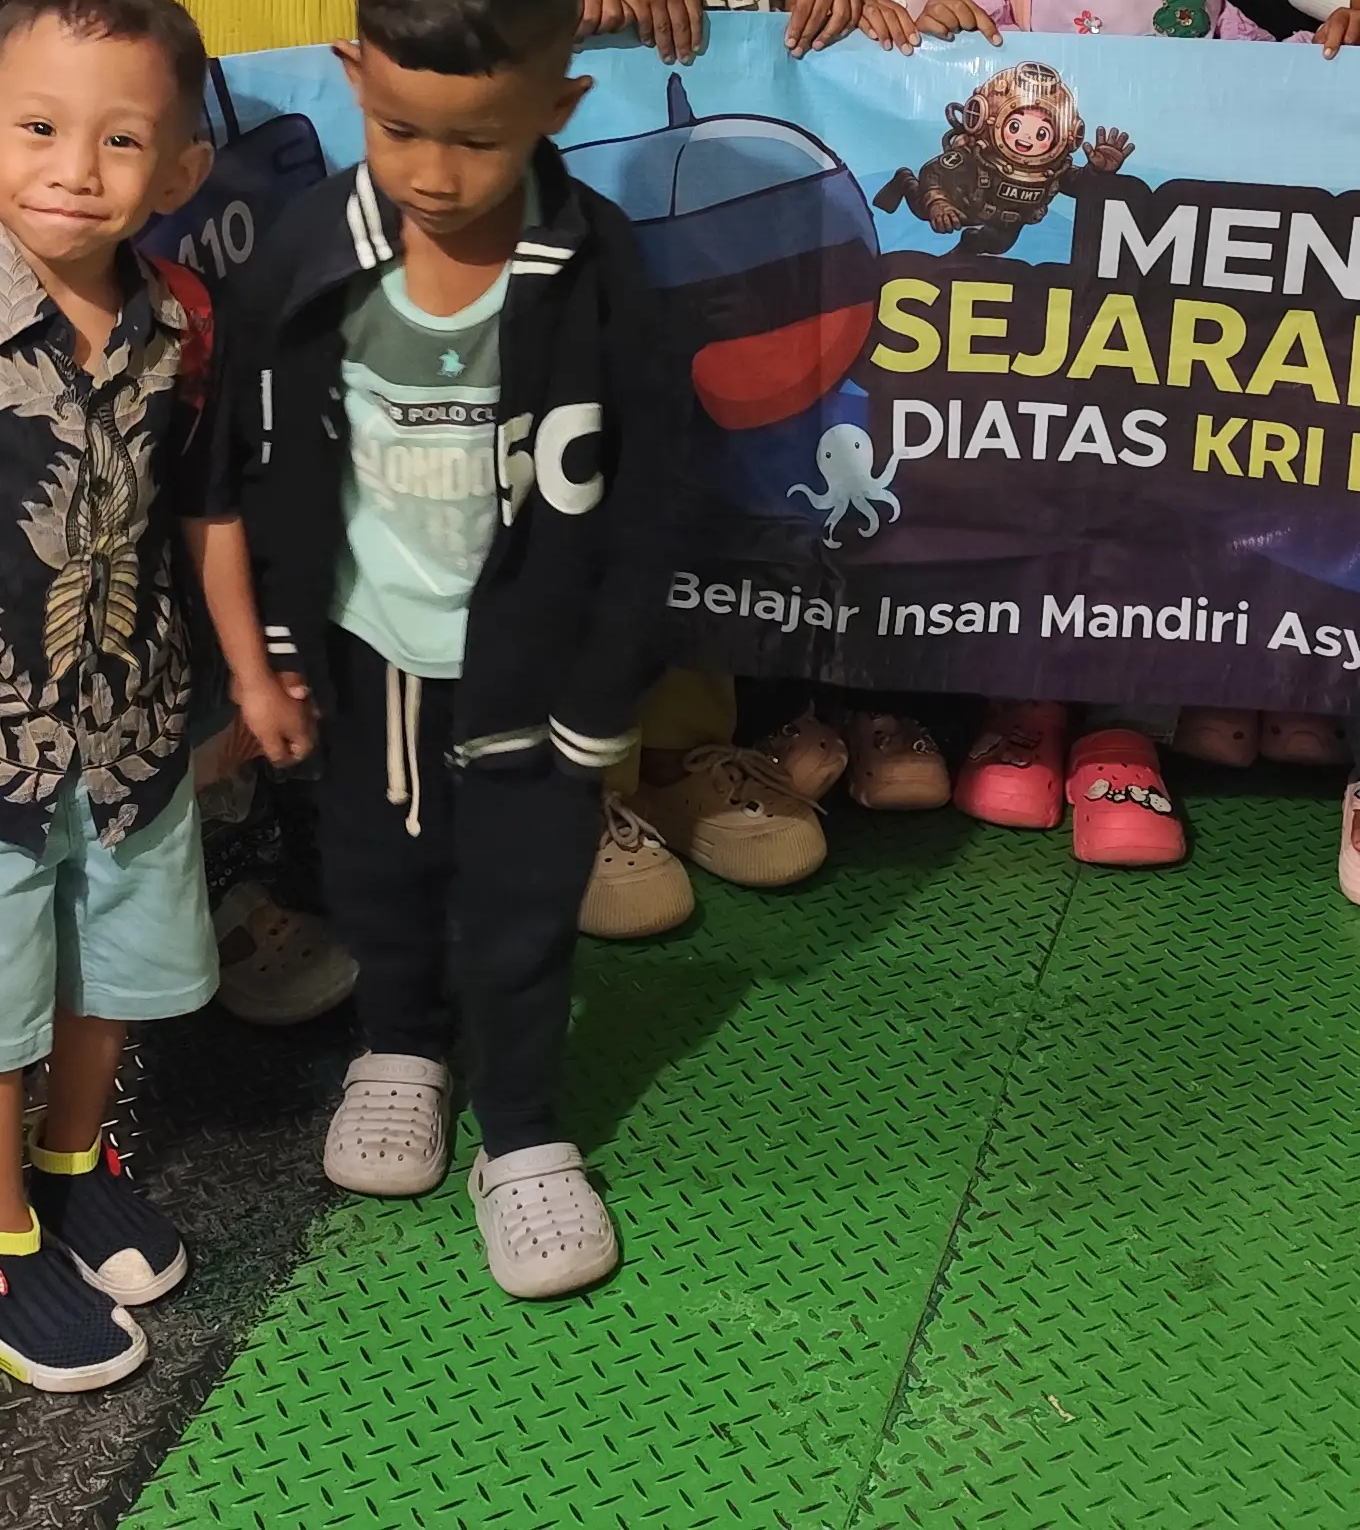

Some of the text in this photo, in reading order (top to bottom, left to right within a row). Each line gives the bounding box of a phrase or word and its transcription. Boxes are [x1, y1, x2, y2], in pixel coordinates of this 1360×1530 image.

[177, 200, 254, 280] 410
[408, 406, 467, 422] POLO
[893, 399, 1168, 468] DIATAS
[1192, 414, 1325, 486] KRI
[665, 570, 860, 634] Belajar
[877, 596, 1021, 637] Insan
[1041, 593, 1250, 646] Mandiri
